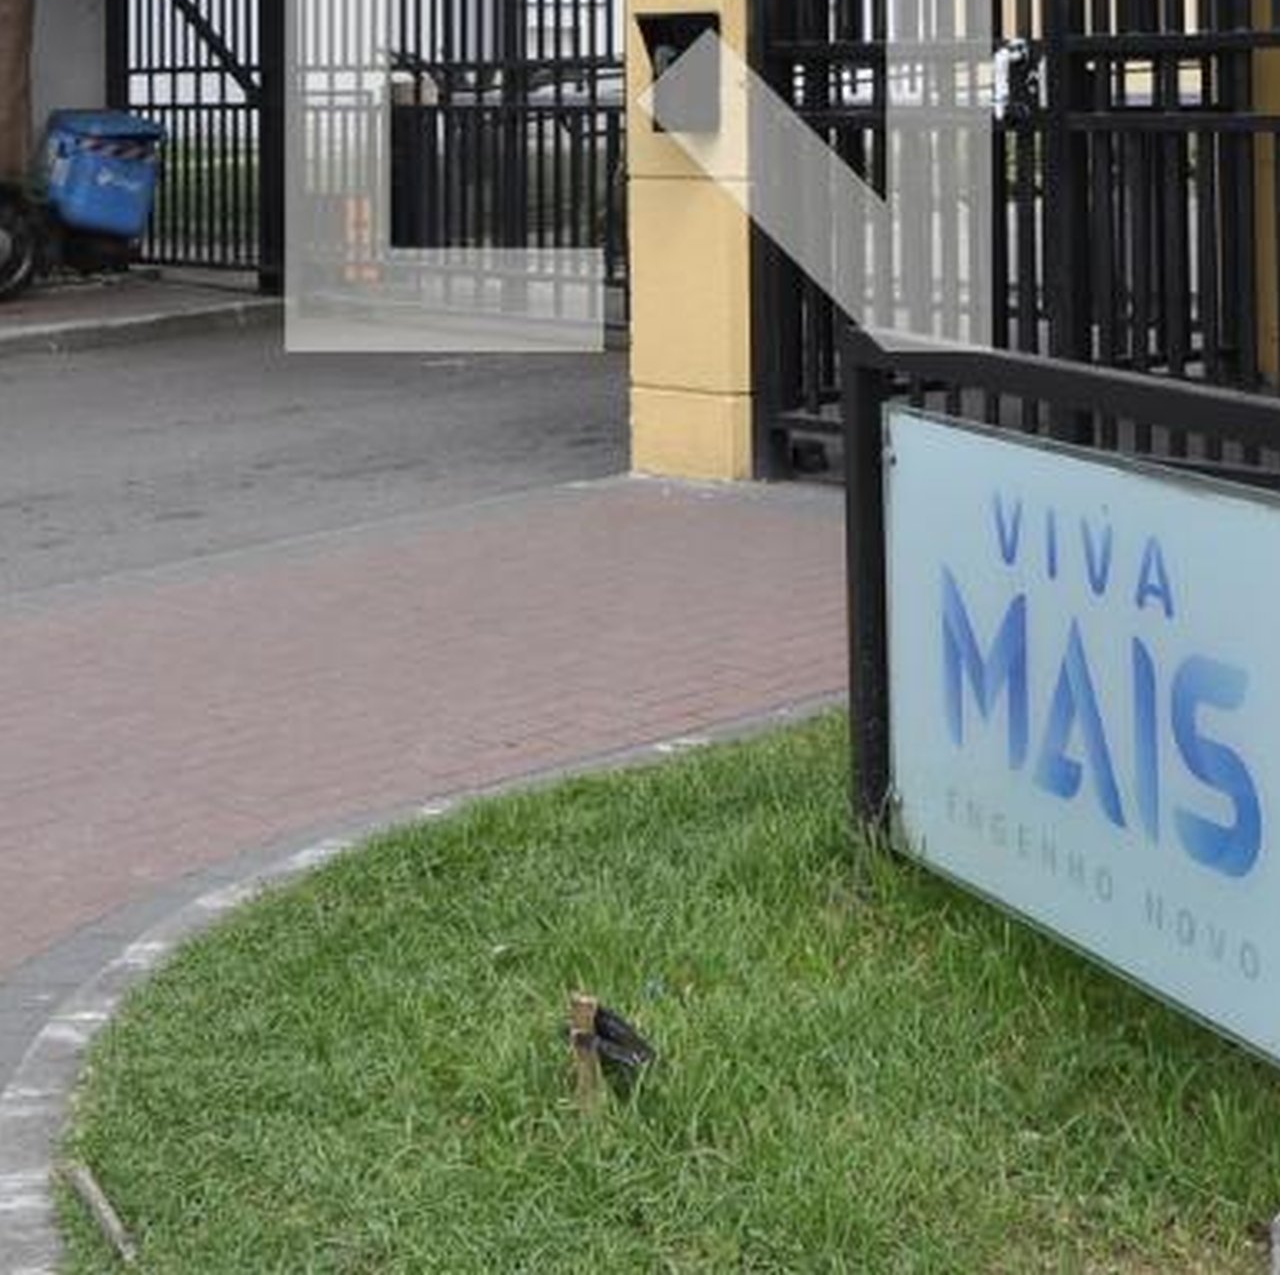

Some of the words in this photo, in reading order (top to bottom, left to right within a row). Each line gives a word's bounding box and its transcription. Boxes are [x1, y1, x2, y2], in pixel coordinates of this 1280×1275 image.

[993, 489, 1175, 620] VIVA
[940, 562, 1263, 879] MAIS
[945, 786, 1114, 903] ENGENHO
[1143, 885, 1262, 982] NOVO
